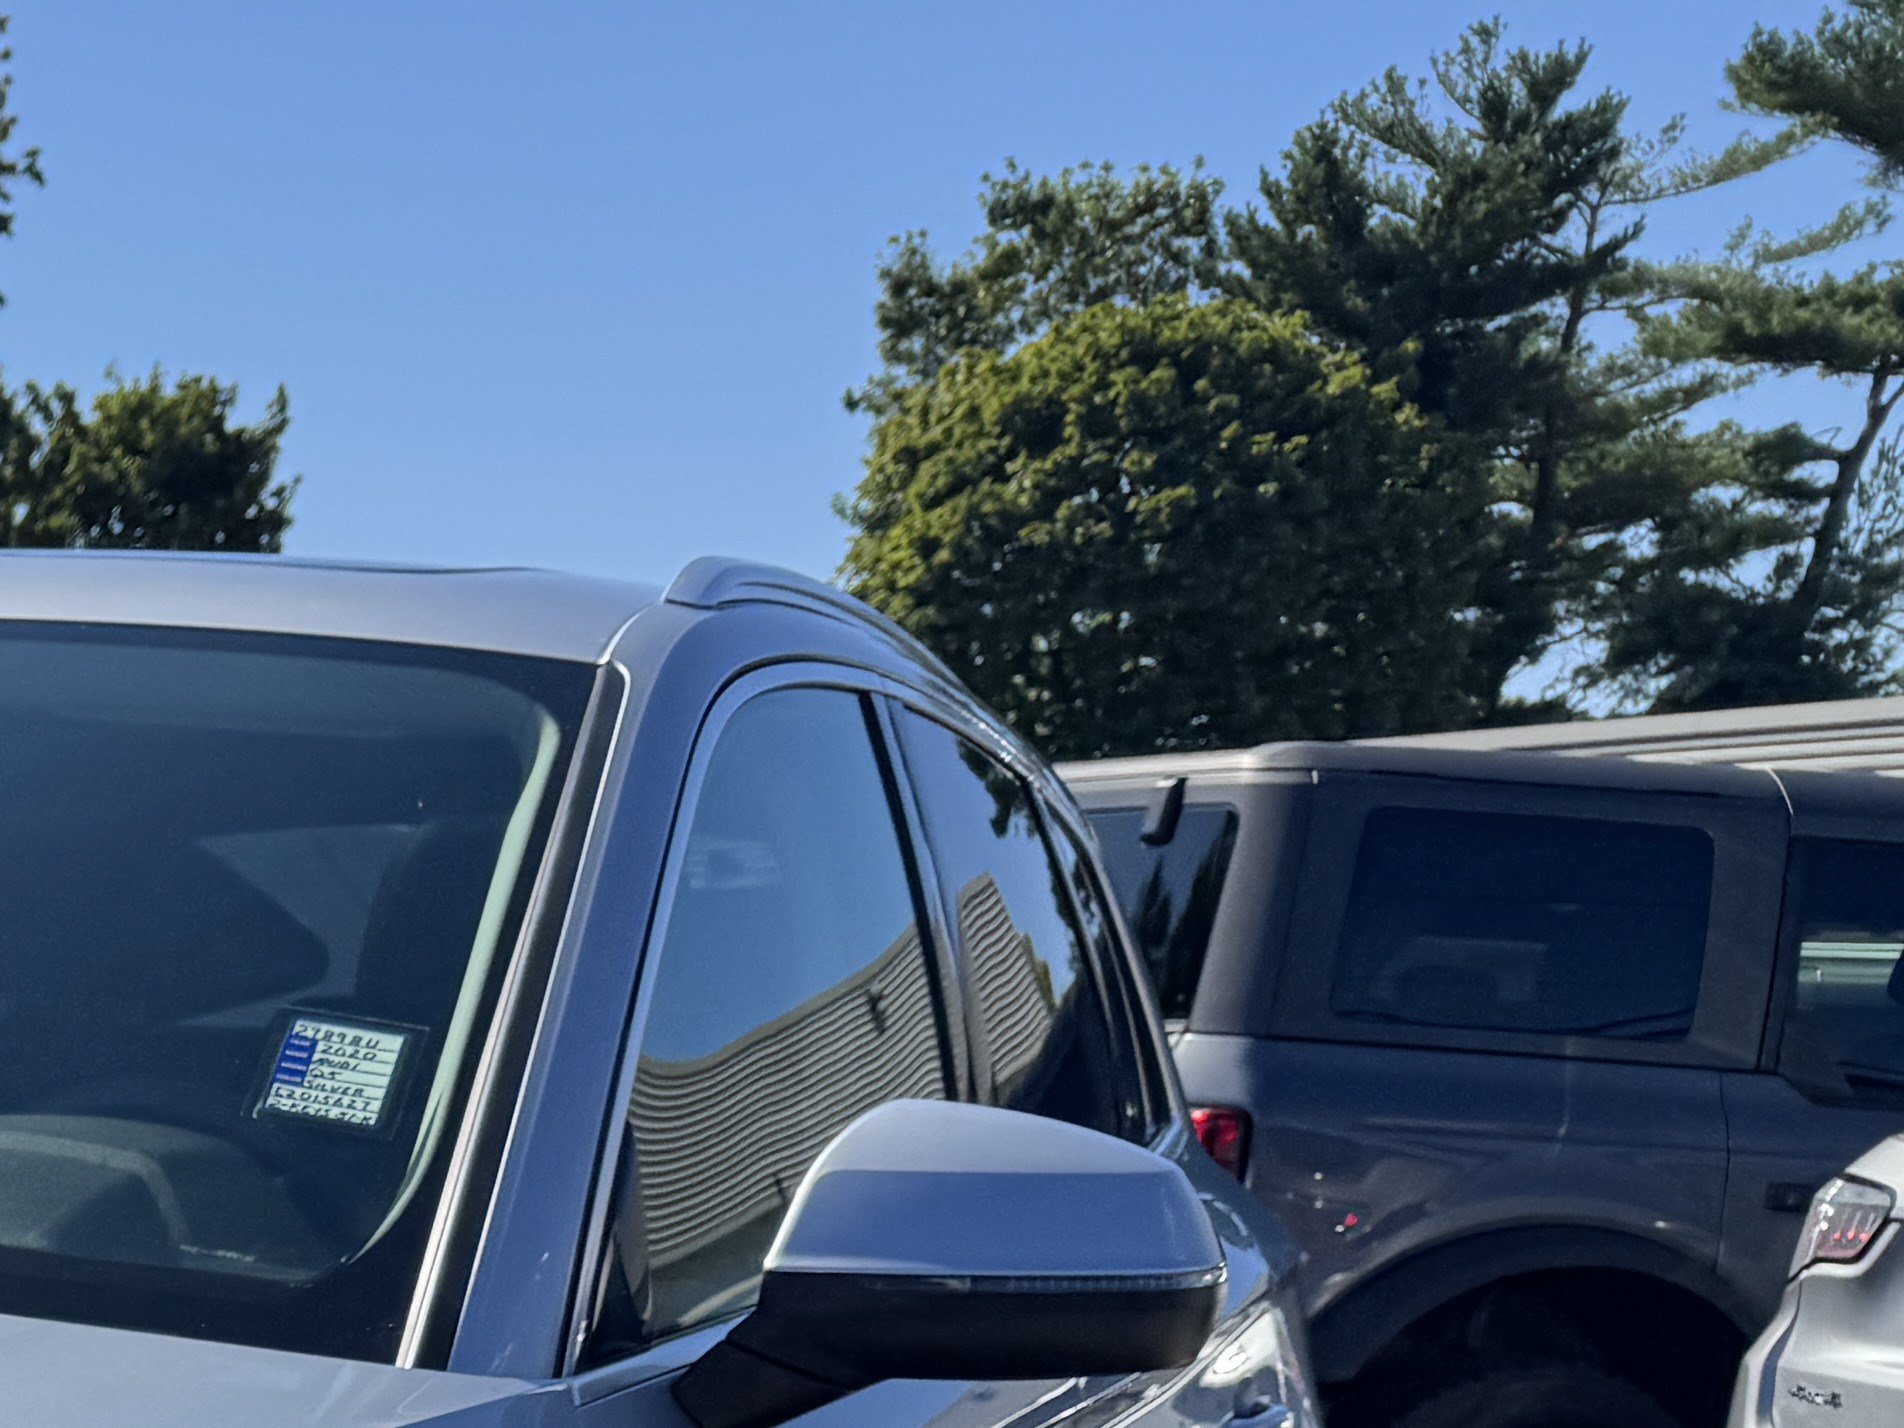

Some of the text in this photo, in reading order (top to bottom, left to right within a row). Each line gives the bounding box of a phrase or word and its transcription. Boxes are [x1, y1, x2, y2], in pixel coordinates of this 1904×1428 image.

[321, 1043, 378, 1061] 2020
[310, 1066, 343, 1080] Q5
[306, 1079, 366, 1098] SILVER
